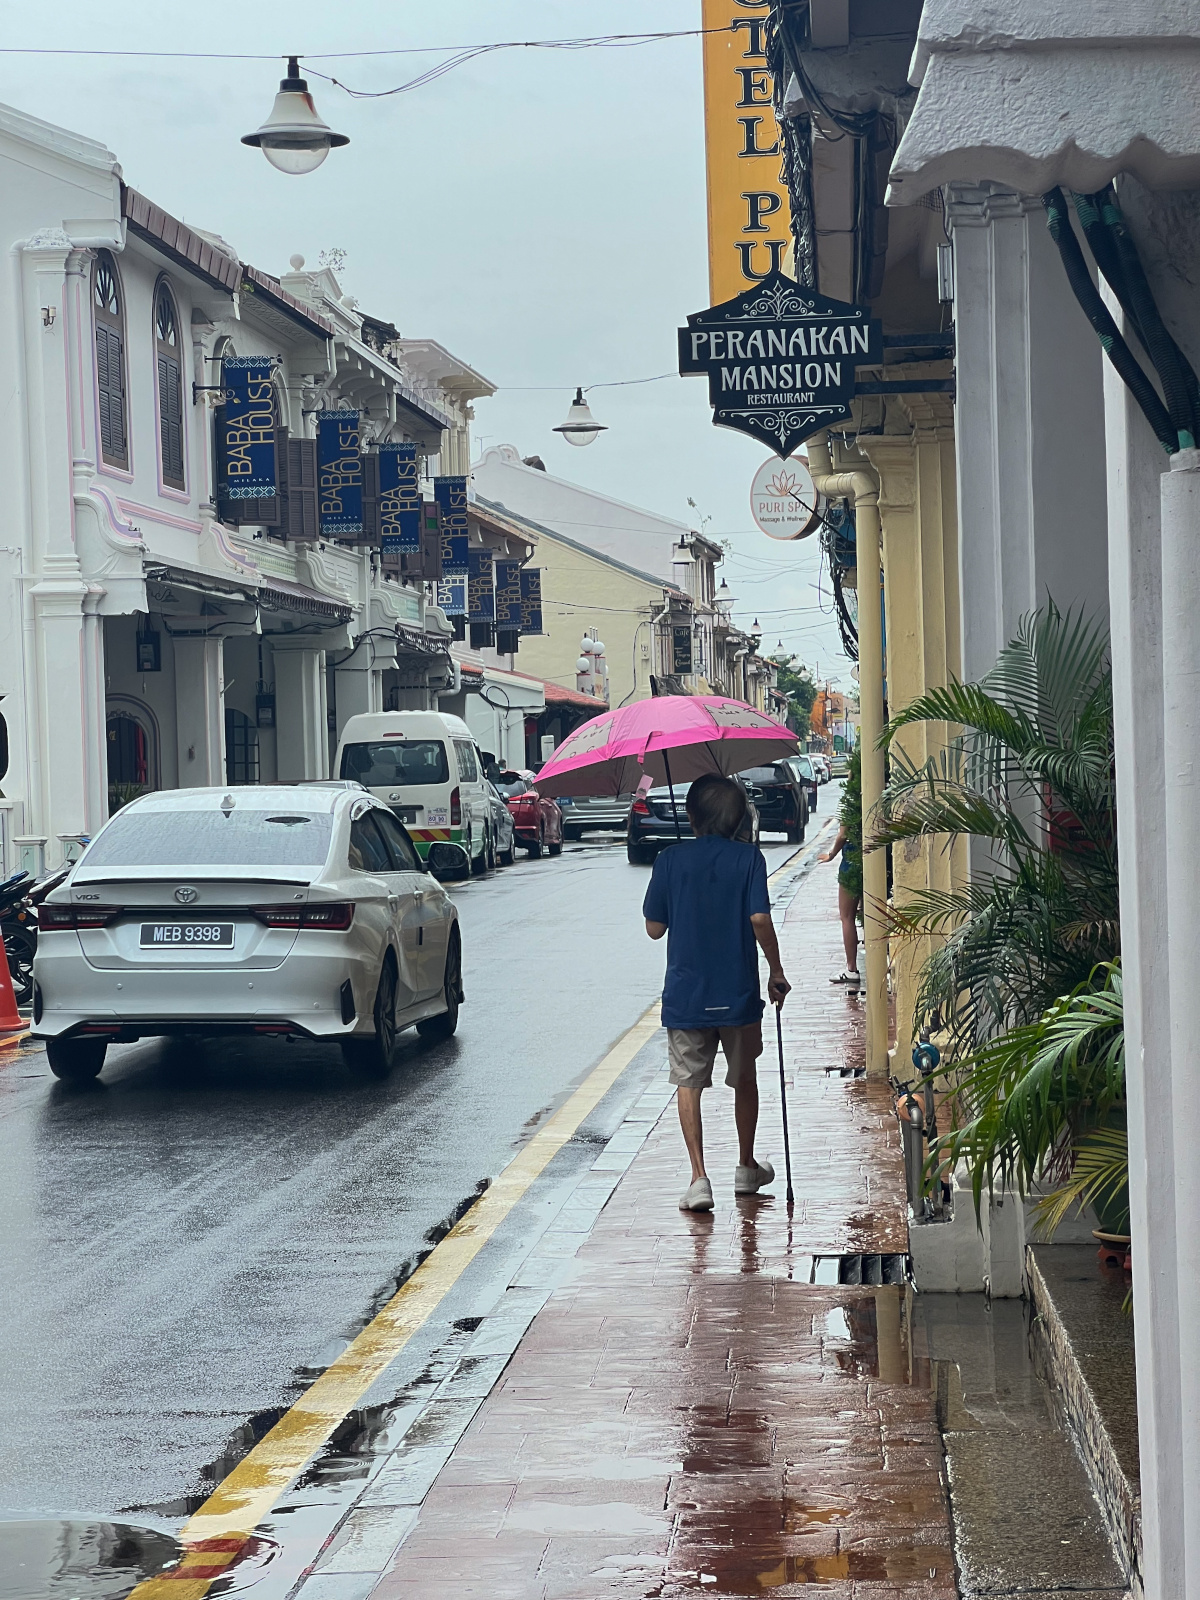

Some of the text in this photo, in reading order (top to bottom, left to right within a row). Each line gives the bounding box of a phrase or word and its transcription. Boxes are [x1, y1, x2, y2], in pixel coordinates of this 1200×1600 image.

[731, 0, 787, 297] TEL PU
[690, 325, 869, 361] PERANAKAN
[721, 362, 841, 391] MANSION
[247, 371, 275, 444] HOUSE
[747, 392, 816, 405] RESTAURANT
[226, 413, 253, 475] BABA
[339, 422, 362, 486] HOUSE
[320, 459, 343, 513] BABA
[397, 453, 419, 511] HOUSE
[380, 486, 401, 536] BABA
[449, 485, 469, 538] HOUSE
[759, 502, 785, 513] PURI
[468, 576, 481, 611] BABA
[479, 555, 493, 595] HOUSE
[507, 566, 521, 604] HOUSE
[496, 586, 511, 620] BABA
[153, 926, 221, 942] MEB 9398
